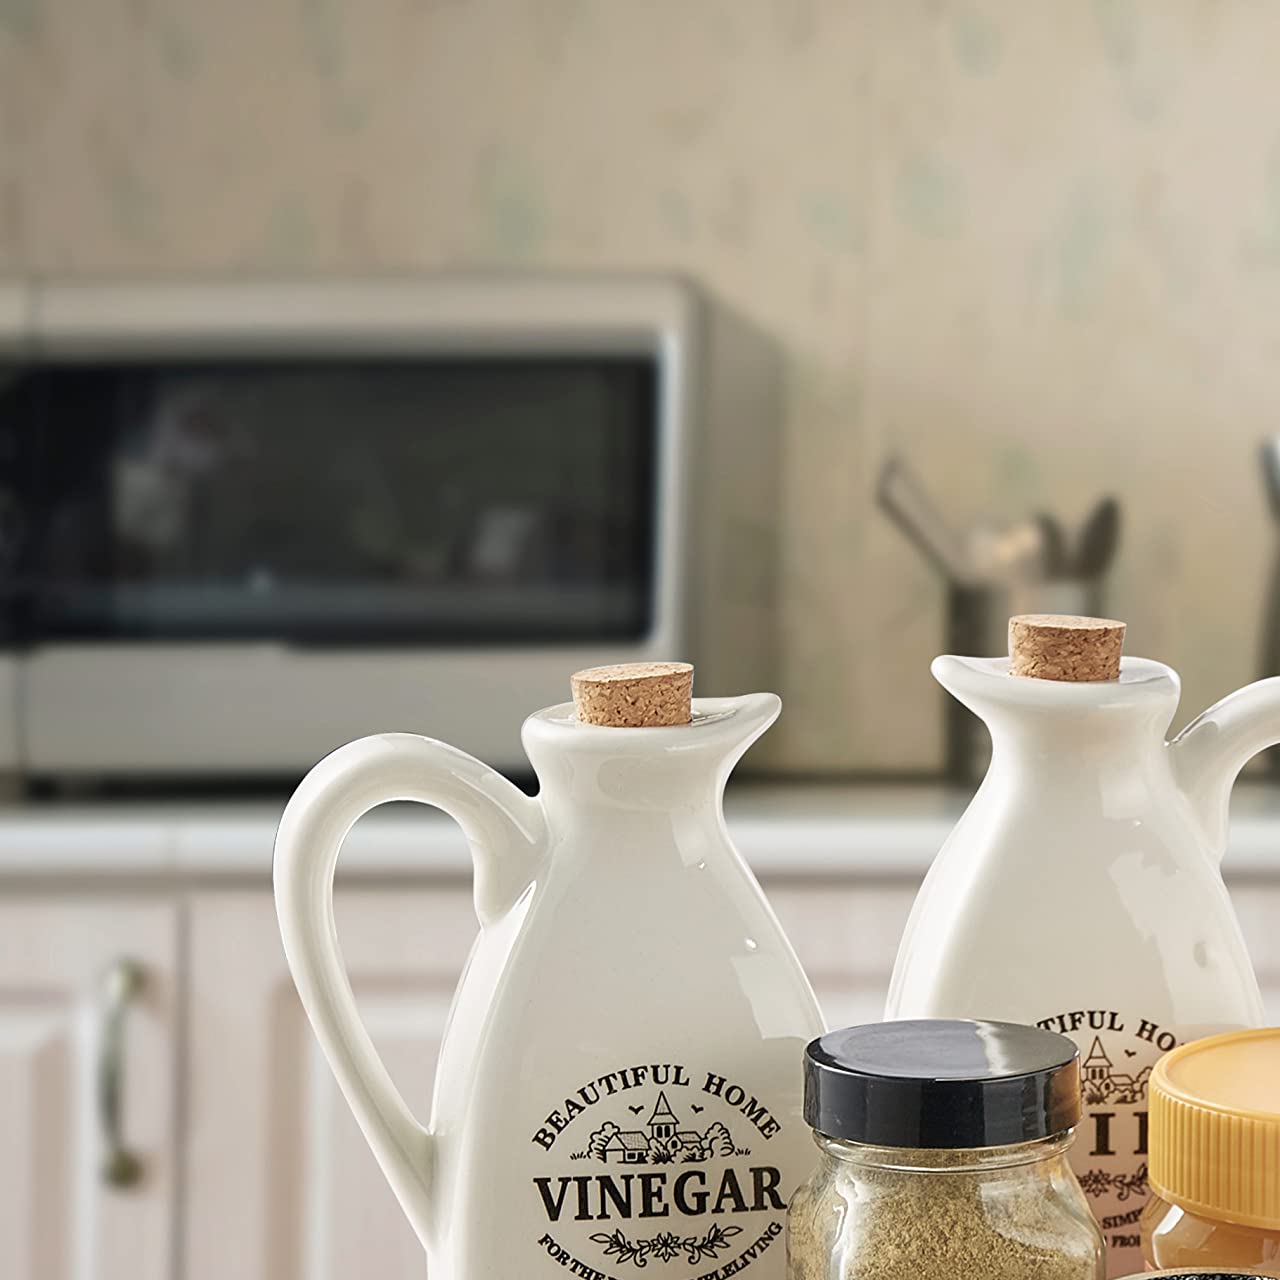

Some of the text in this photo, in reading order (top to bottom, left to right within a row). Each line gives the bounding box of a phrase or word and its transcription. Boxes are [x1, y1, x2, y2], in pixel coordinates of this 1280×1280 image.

[1037, 1010, 1177, 1052] TIFUL HO
[532, 1064, 782, 1151] BEAUTIFUL HOME
[532, 1166, 788, 1223] VINEGAR
[537, 1233, 569, 1267] FOR
